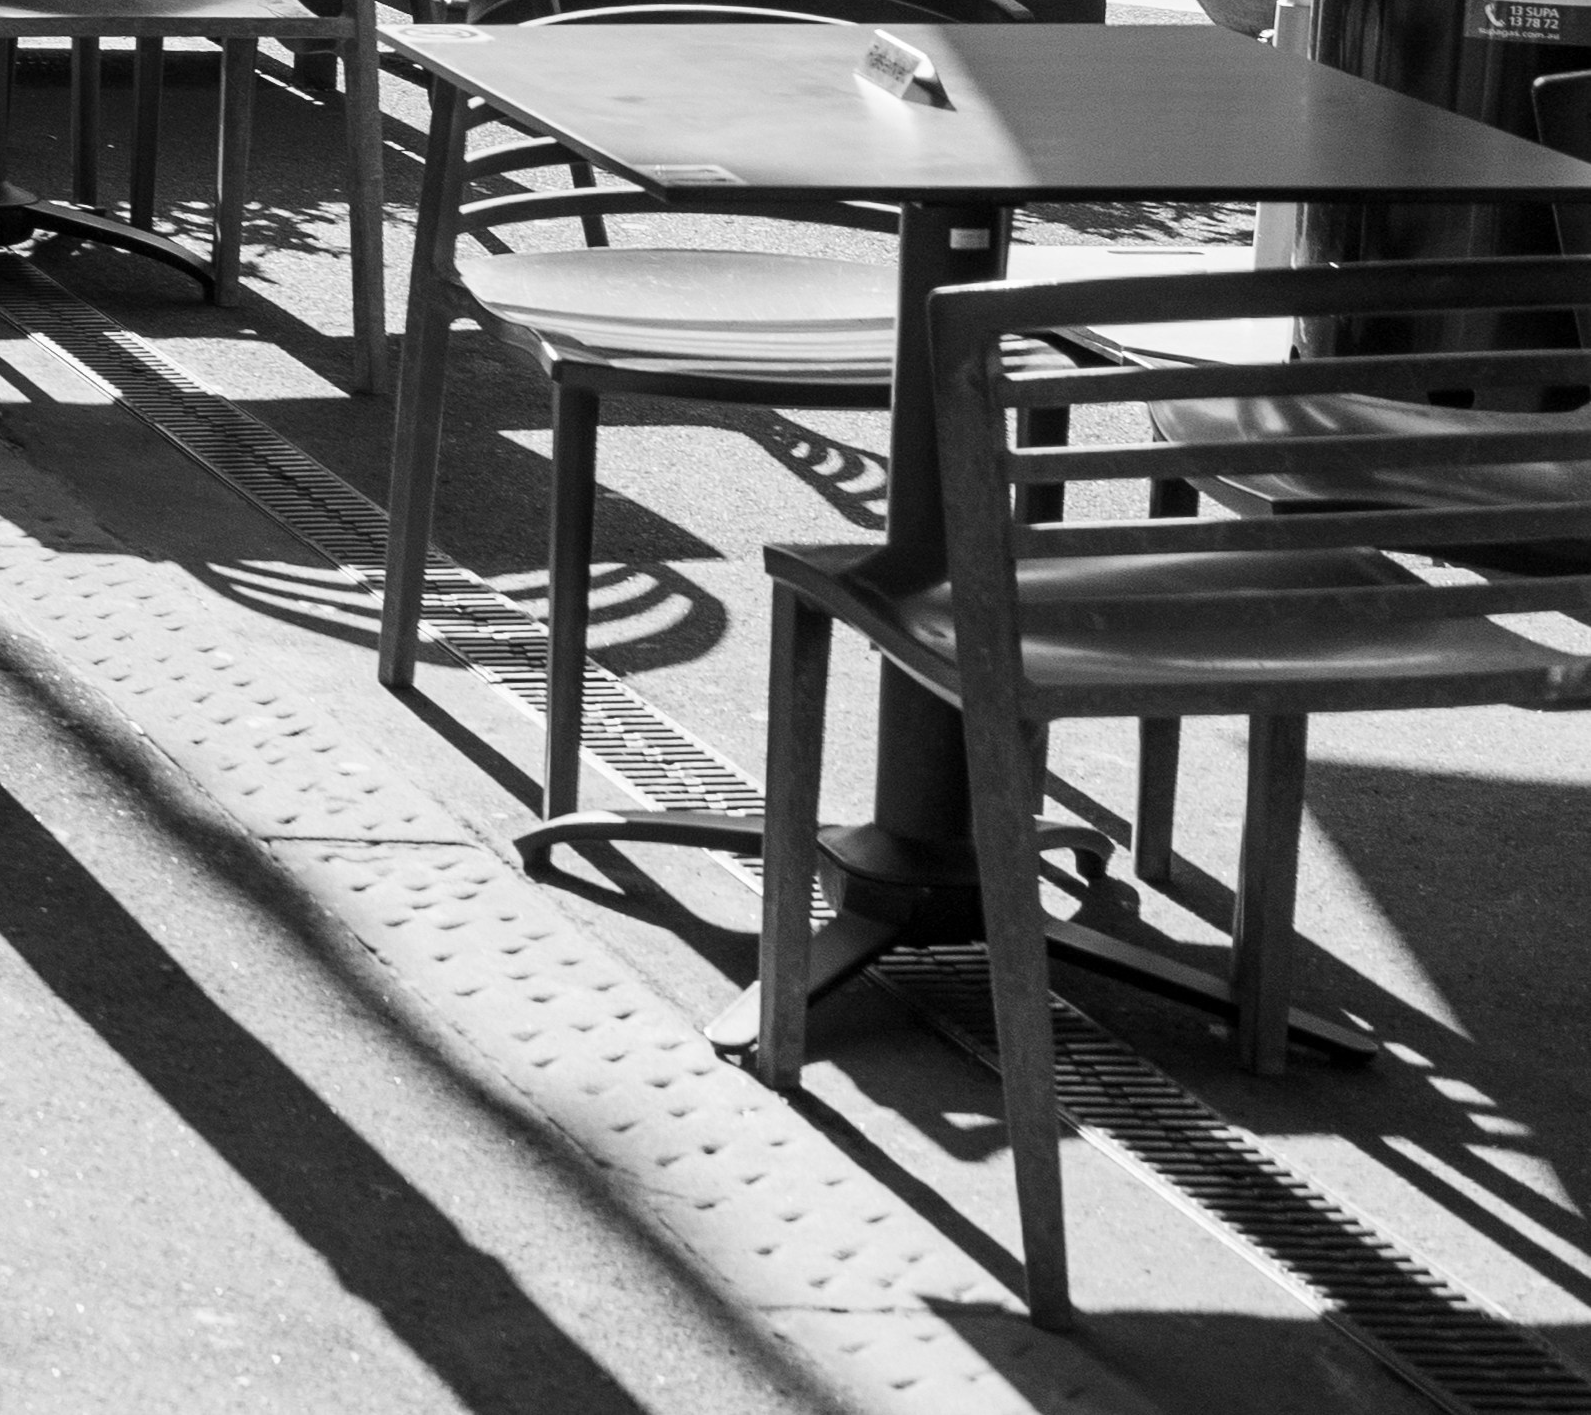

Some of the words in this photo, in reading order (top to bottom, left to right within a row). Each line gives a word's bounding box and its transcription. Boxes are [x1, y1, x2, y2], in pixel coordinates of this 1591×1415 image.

[1508, 4, 1524, 16] 13
[1525, 6, 1560, 19] SUPA
[1508, 16, 1524, 28] 13
[1525, 17, 1541, 29] 78
[1543, 18, 1560, 30] 72
